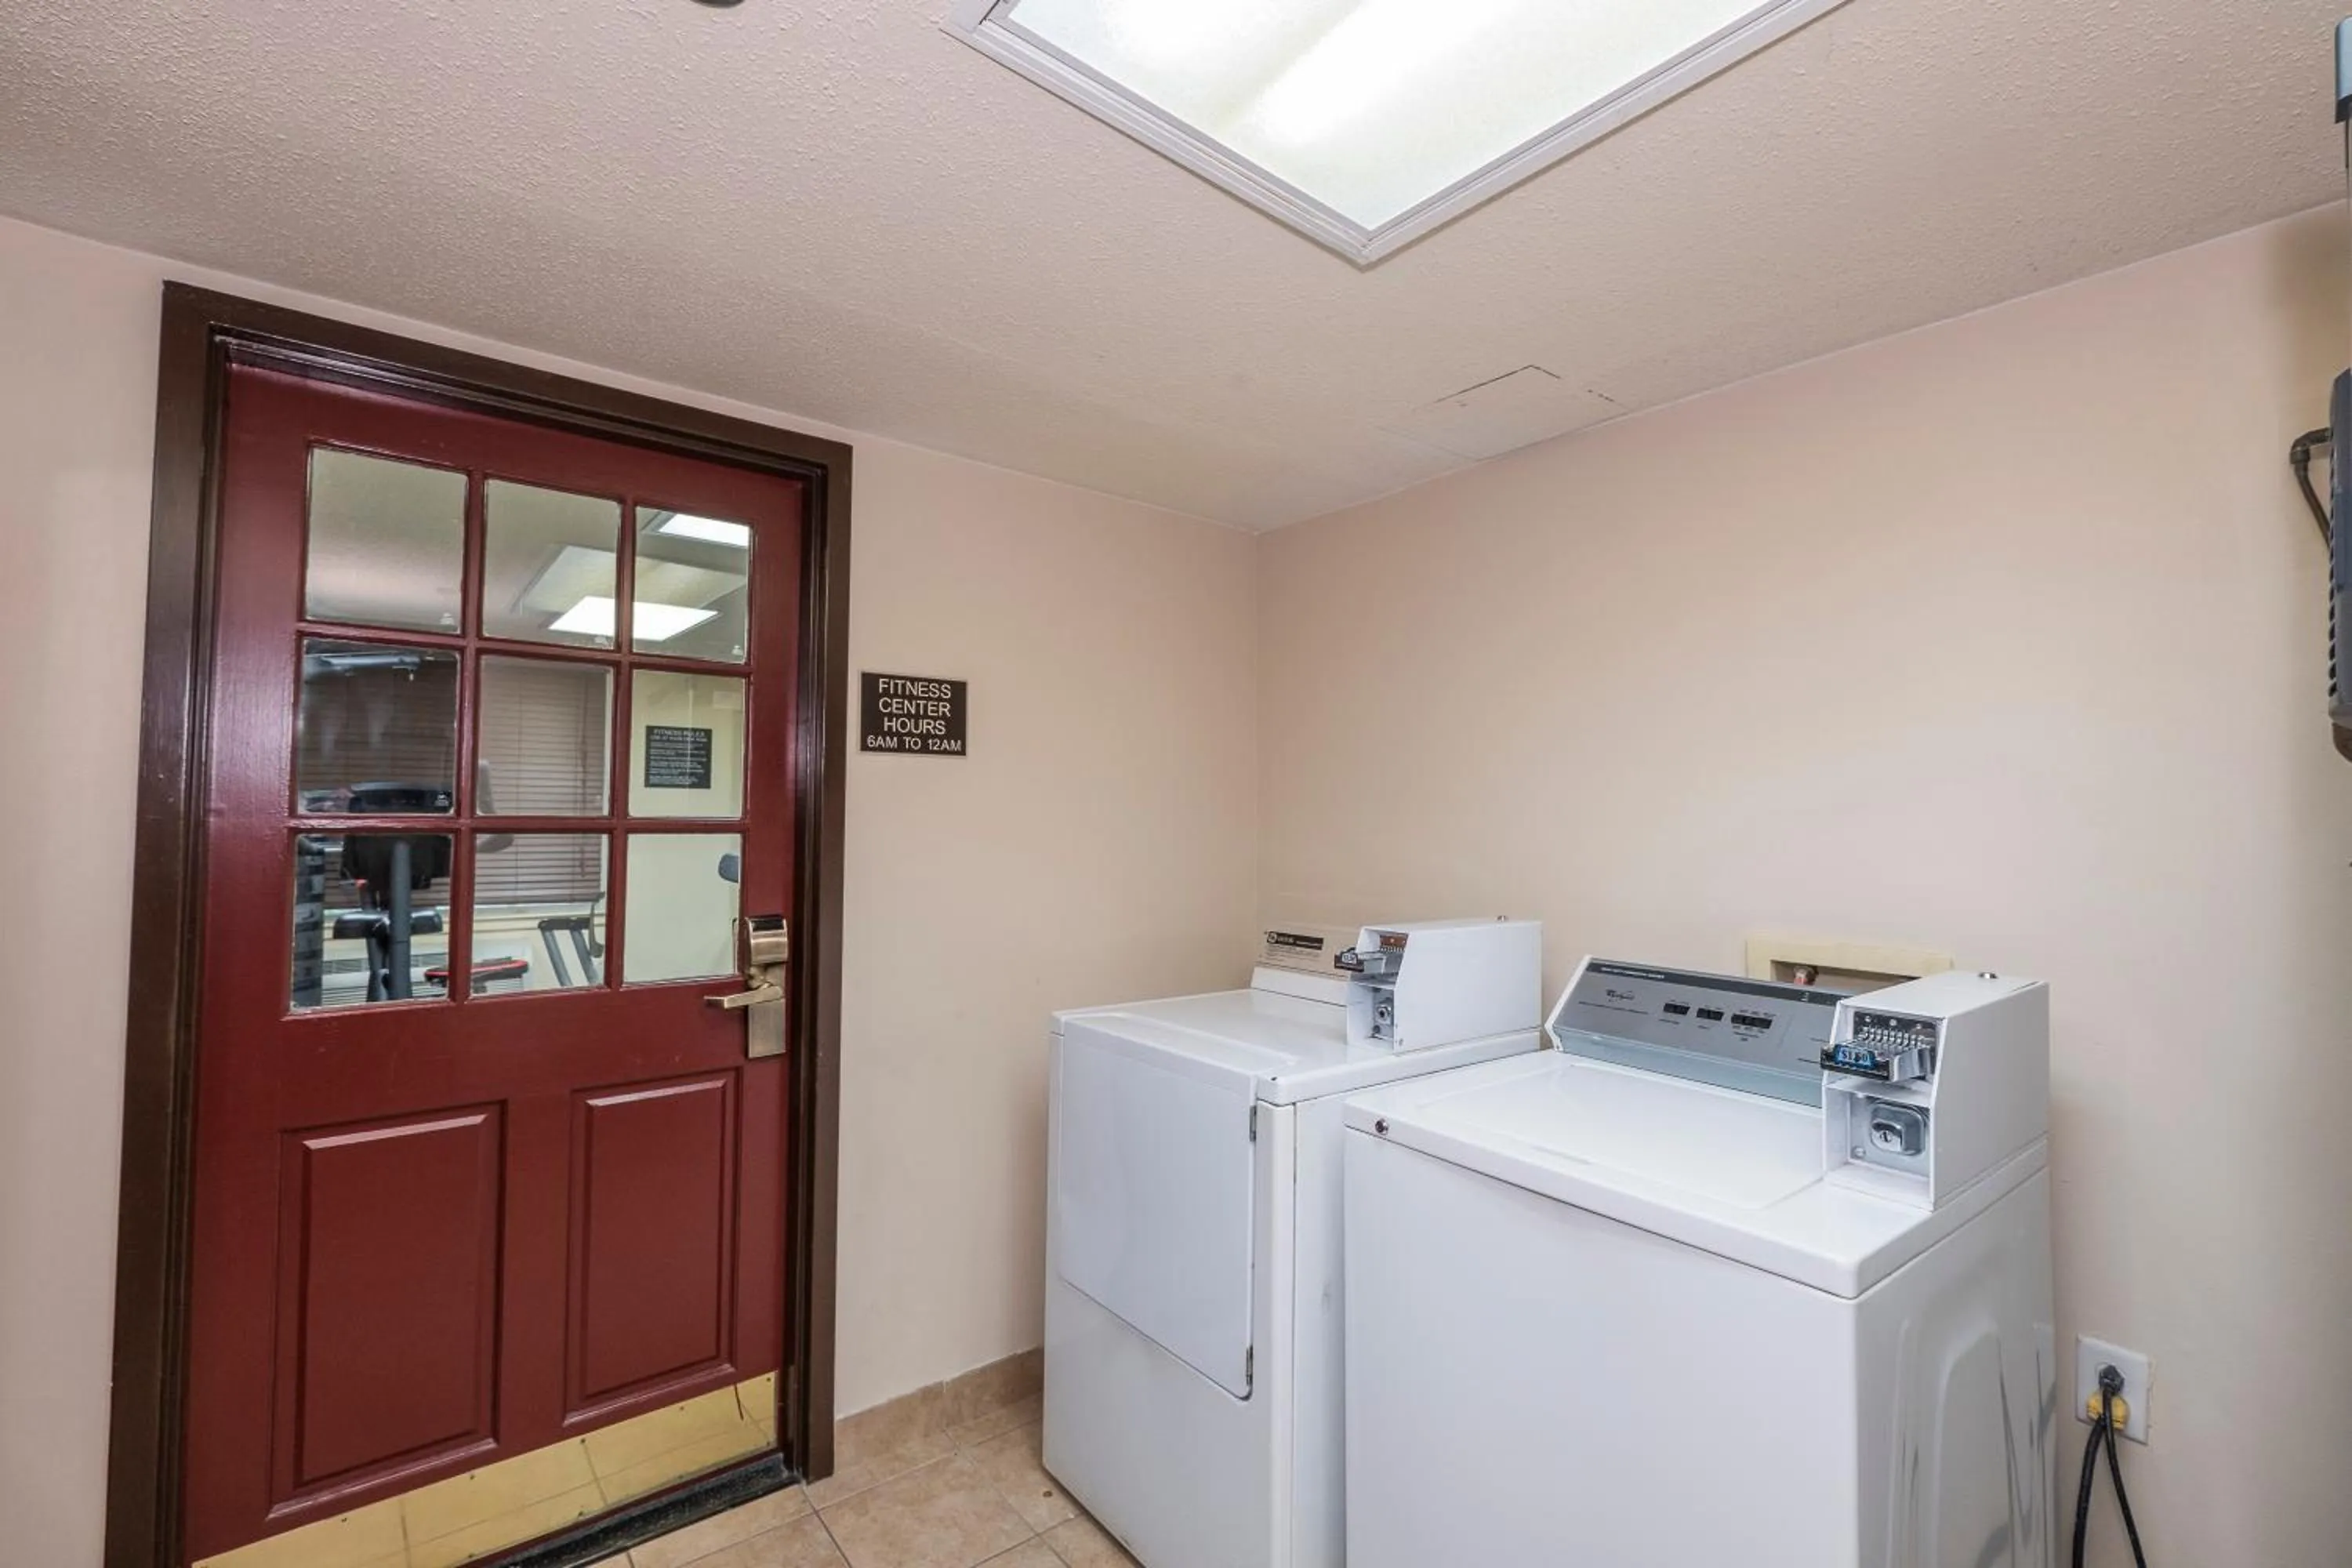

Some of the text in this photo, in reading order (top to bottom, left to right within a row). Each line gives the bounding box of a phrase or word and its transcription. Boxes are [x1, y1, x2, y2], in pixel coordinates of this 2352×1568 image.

[879, 678, 951, 699] FITNESS
[879, 697, 951, 717] CENTER
[884, 717, 946, 735] HOURS
[866, 735, 962, 751] 6AM TO 12AM
